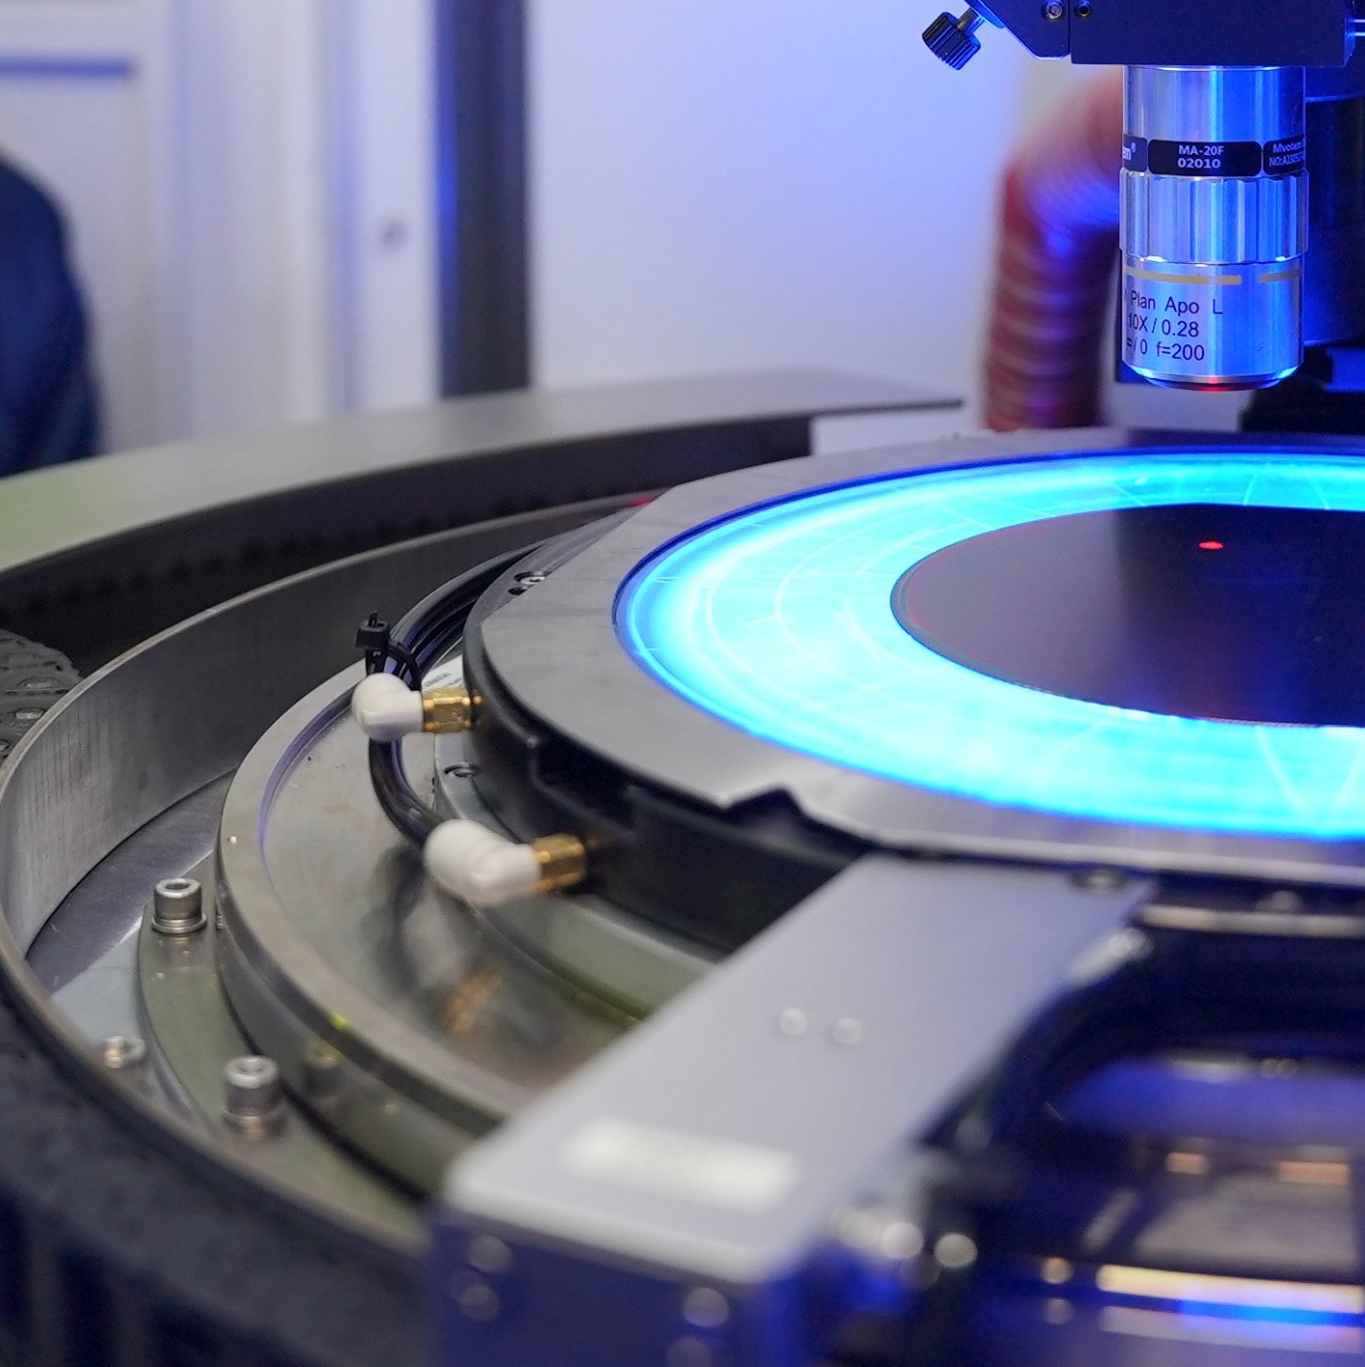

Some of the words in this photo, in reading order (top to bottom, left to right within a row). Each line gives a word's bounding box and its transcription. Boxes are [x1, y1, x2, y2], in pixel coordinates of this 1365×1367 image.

[1178, 144, 1224, 156] MA-20F
[1177, 158, 1221, 169] 02010
[1130, 289, 1156, 311] Plan
[1164, 296, 1200, 316] Apo
[1212, 298, 1224, 315] L
[1161, 319, 1200, 338] 0.28
[1156, 340, 1205, 362] f=200
